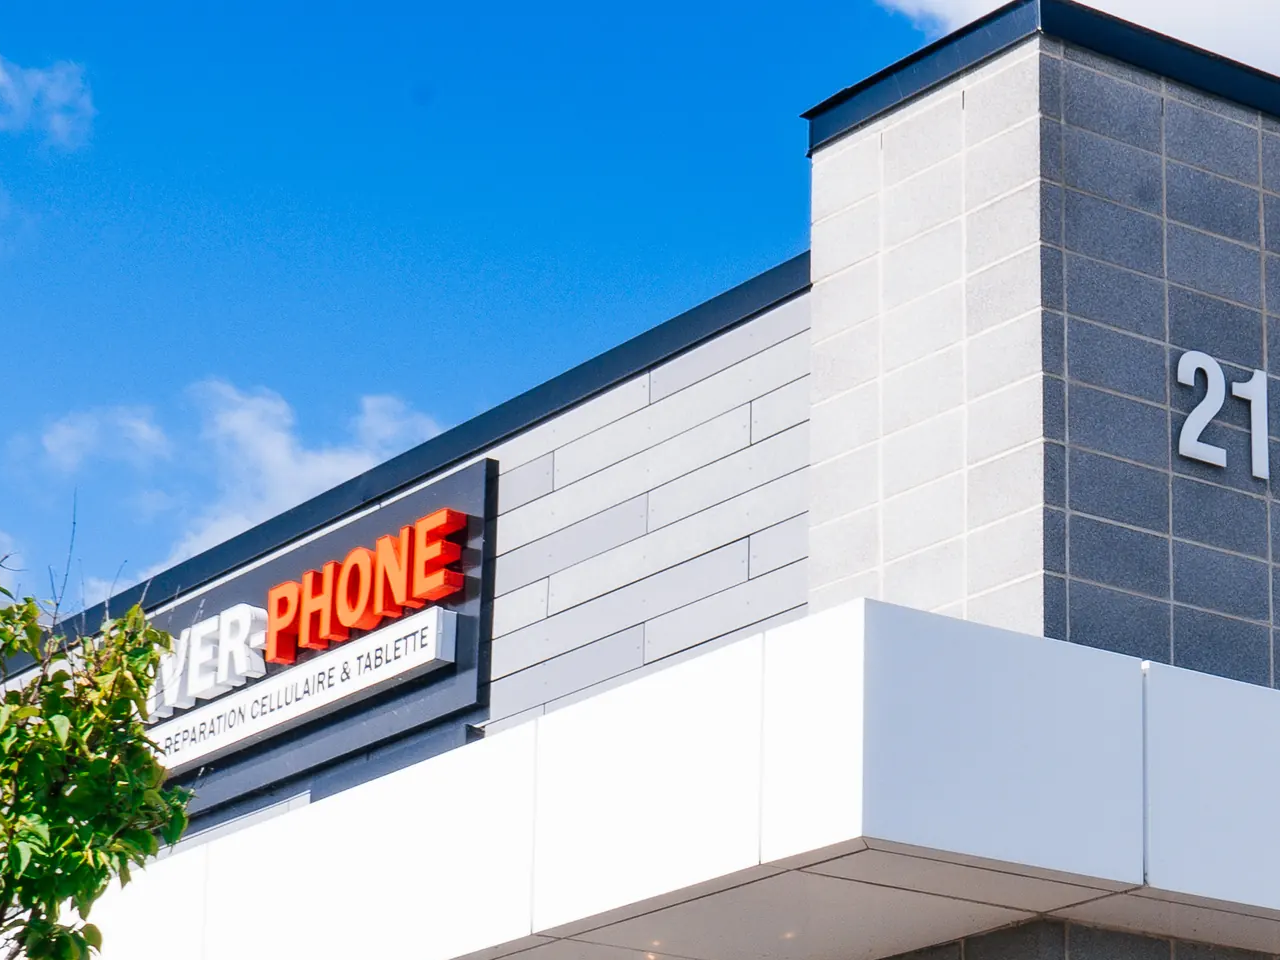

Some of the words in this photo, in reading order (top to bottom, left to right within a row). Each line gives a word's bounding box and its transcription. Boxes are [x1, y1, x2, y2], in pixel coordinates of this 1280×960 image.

[147, 507, 468, 722] VER-PHONE
[165, 707, 245, 755] RÉPARATION
[250, 667, 335, 720] CELLULAIRE
[340, 660, 351, 683] &
[356, 626, 429, 676] TABLETTE
